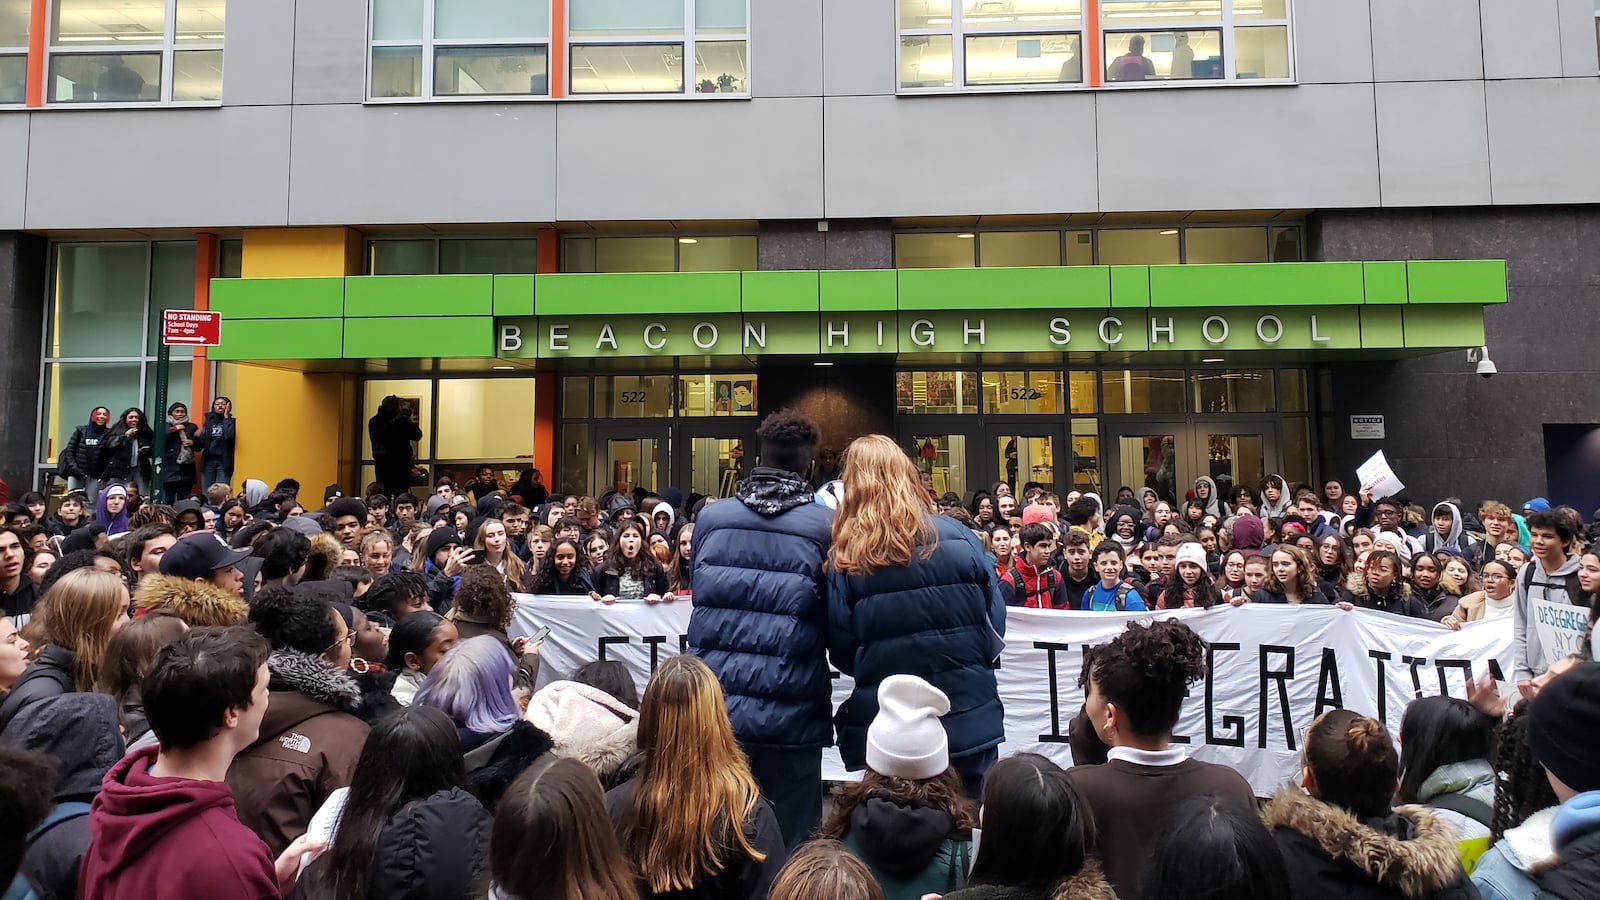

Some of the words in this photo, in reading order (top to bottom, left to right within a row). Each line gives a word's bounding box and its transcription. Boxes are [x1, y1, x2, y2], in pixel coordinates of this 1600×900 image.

[501, 321, 767, 351] BEACON
[827, 319, 986, 346] HIGH
[1049, 315, 1331, 345] SCHOOL
[622, 391, 646, 403] 522
[1011, 388, 1036, 400] 522
